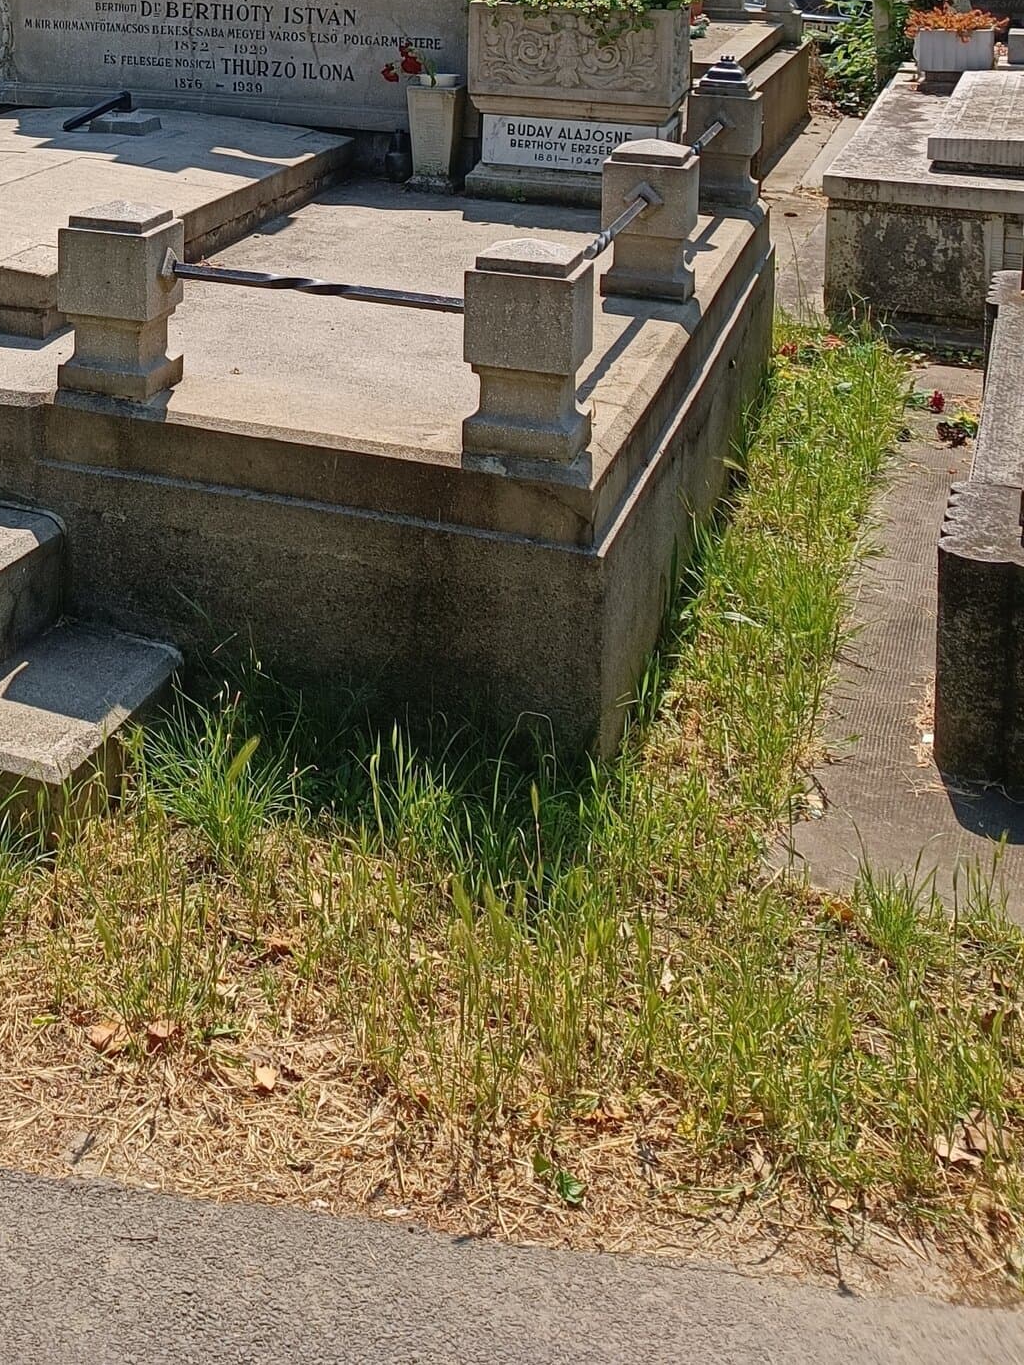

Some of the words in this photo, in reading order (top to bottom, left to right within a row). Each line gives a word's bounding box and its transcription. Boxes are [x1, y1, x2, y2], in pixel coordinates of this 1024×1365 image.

[284, 2, 357, 27] ISTVÁN
[270, 26, 306, 42] VÁROS
[234, 44, 267, 55] 1929
[104, 50, 117, 64] ÉS
[221, 56, 296, 79] THURZÓ
[303, 62, 355, 82] ILONA
[233, 81, 263, 93] 1939
[571, 141, 615, 156] ERZSÉB
